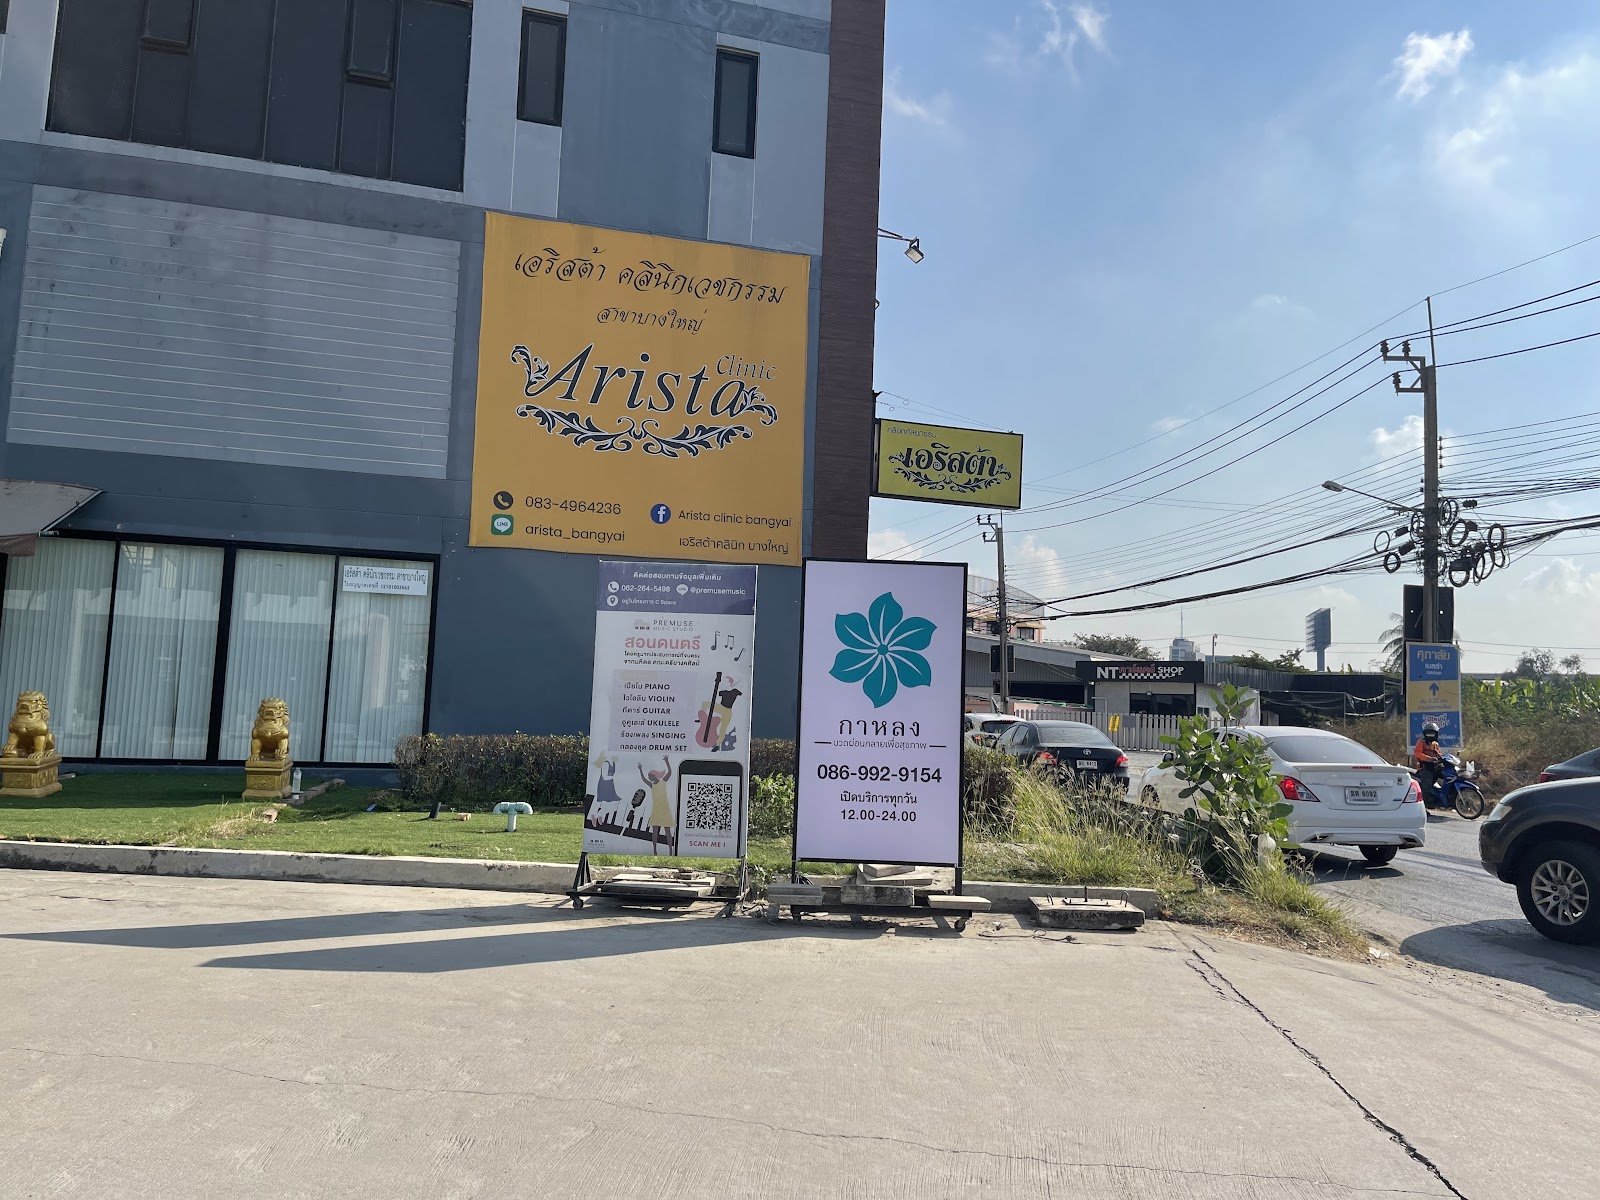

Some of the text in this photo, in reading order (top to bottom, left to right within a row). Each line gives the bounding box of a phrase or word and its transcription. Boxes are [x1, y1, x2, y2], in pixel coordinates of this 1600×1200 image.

[514, 246, 789, 304] เอริสต้า คลินิกเวชกรรม
[596, 307, 709, 336] สาขาบางใหญ่
[716, 354, 777, 380] Clinic
[524, 343, 752, 418] Arista
[900, 442, 999, 477] เอริสต้า
[525, 495, 622, 516] 083-4964236
[678, 510, 792, 530] Arista clinic bangyai
[525, 523, 625, 544] arista_bangyai
[679, 536, 790, 555] เอริสต้าคลินิก บางใหญ่
[633, 571, 722, 582] ติดต่อสอบถามข้อมูลเพิ่มเติม
[690, 586, 746, 595] @premusemusic
[653, 619, 694, 627] PREMUSE
[624, 635, 701, 650] สอนดนตรี
[1096, 666, 1119, 679] NT
[1157, 666, 1185, 674] SHOP
[648, 695, 675, 703] VIOLIN
[642, 707, 671, 715] GUITAR
[651, 732, 686, 740] SINGING
[839, 719, 920, 737] กาหลง
[833, 737, 927, 751] นวดผ่อนคลายเพื่อสุขภาพ
[817, 764, 942, 783] 086-992-9154
[840, 790, 918, 808] เปิดบริการทุกวัน
[841, 809, 917, 822] 12.00-24.00
